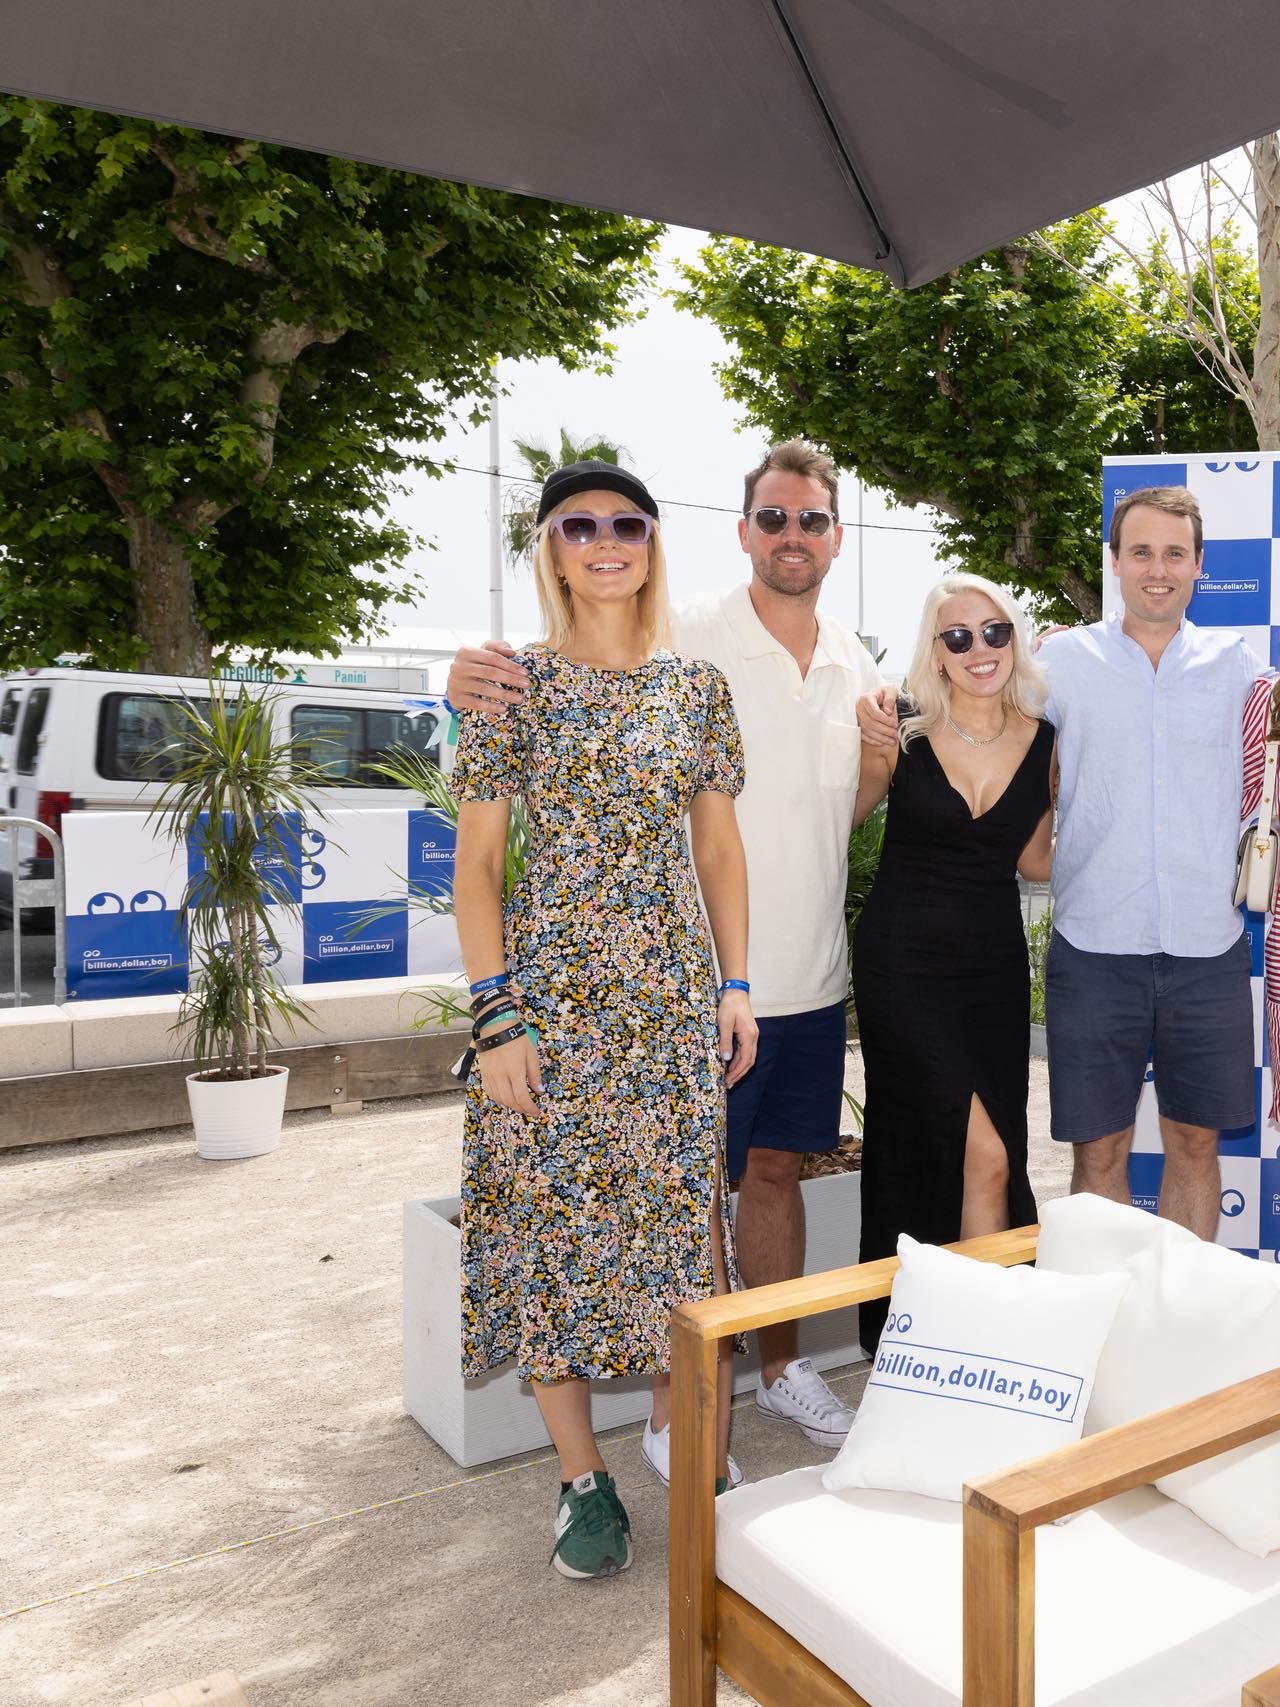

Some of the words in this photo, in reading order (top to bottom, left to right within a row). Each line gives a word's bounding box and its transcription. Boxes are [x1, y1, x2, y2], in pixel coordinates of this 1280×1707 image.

[1200, 582, 1257, 591] billion,dollar,boy
[335, 669, 367, 684] Panini
[322, 943, 390, 954] billion,dollar,boy
[87, 958, 168, 970] billion,dollar,boy
[876, 1351, 1072, 1413] billion,dollar,boy
